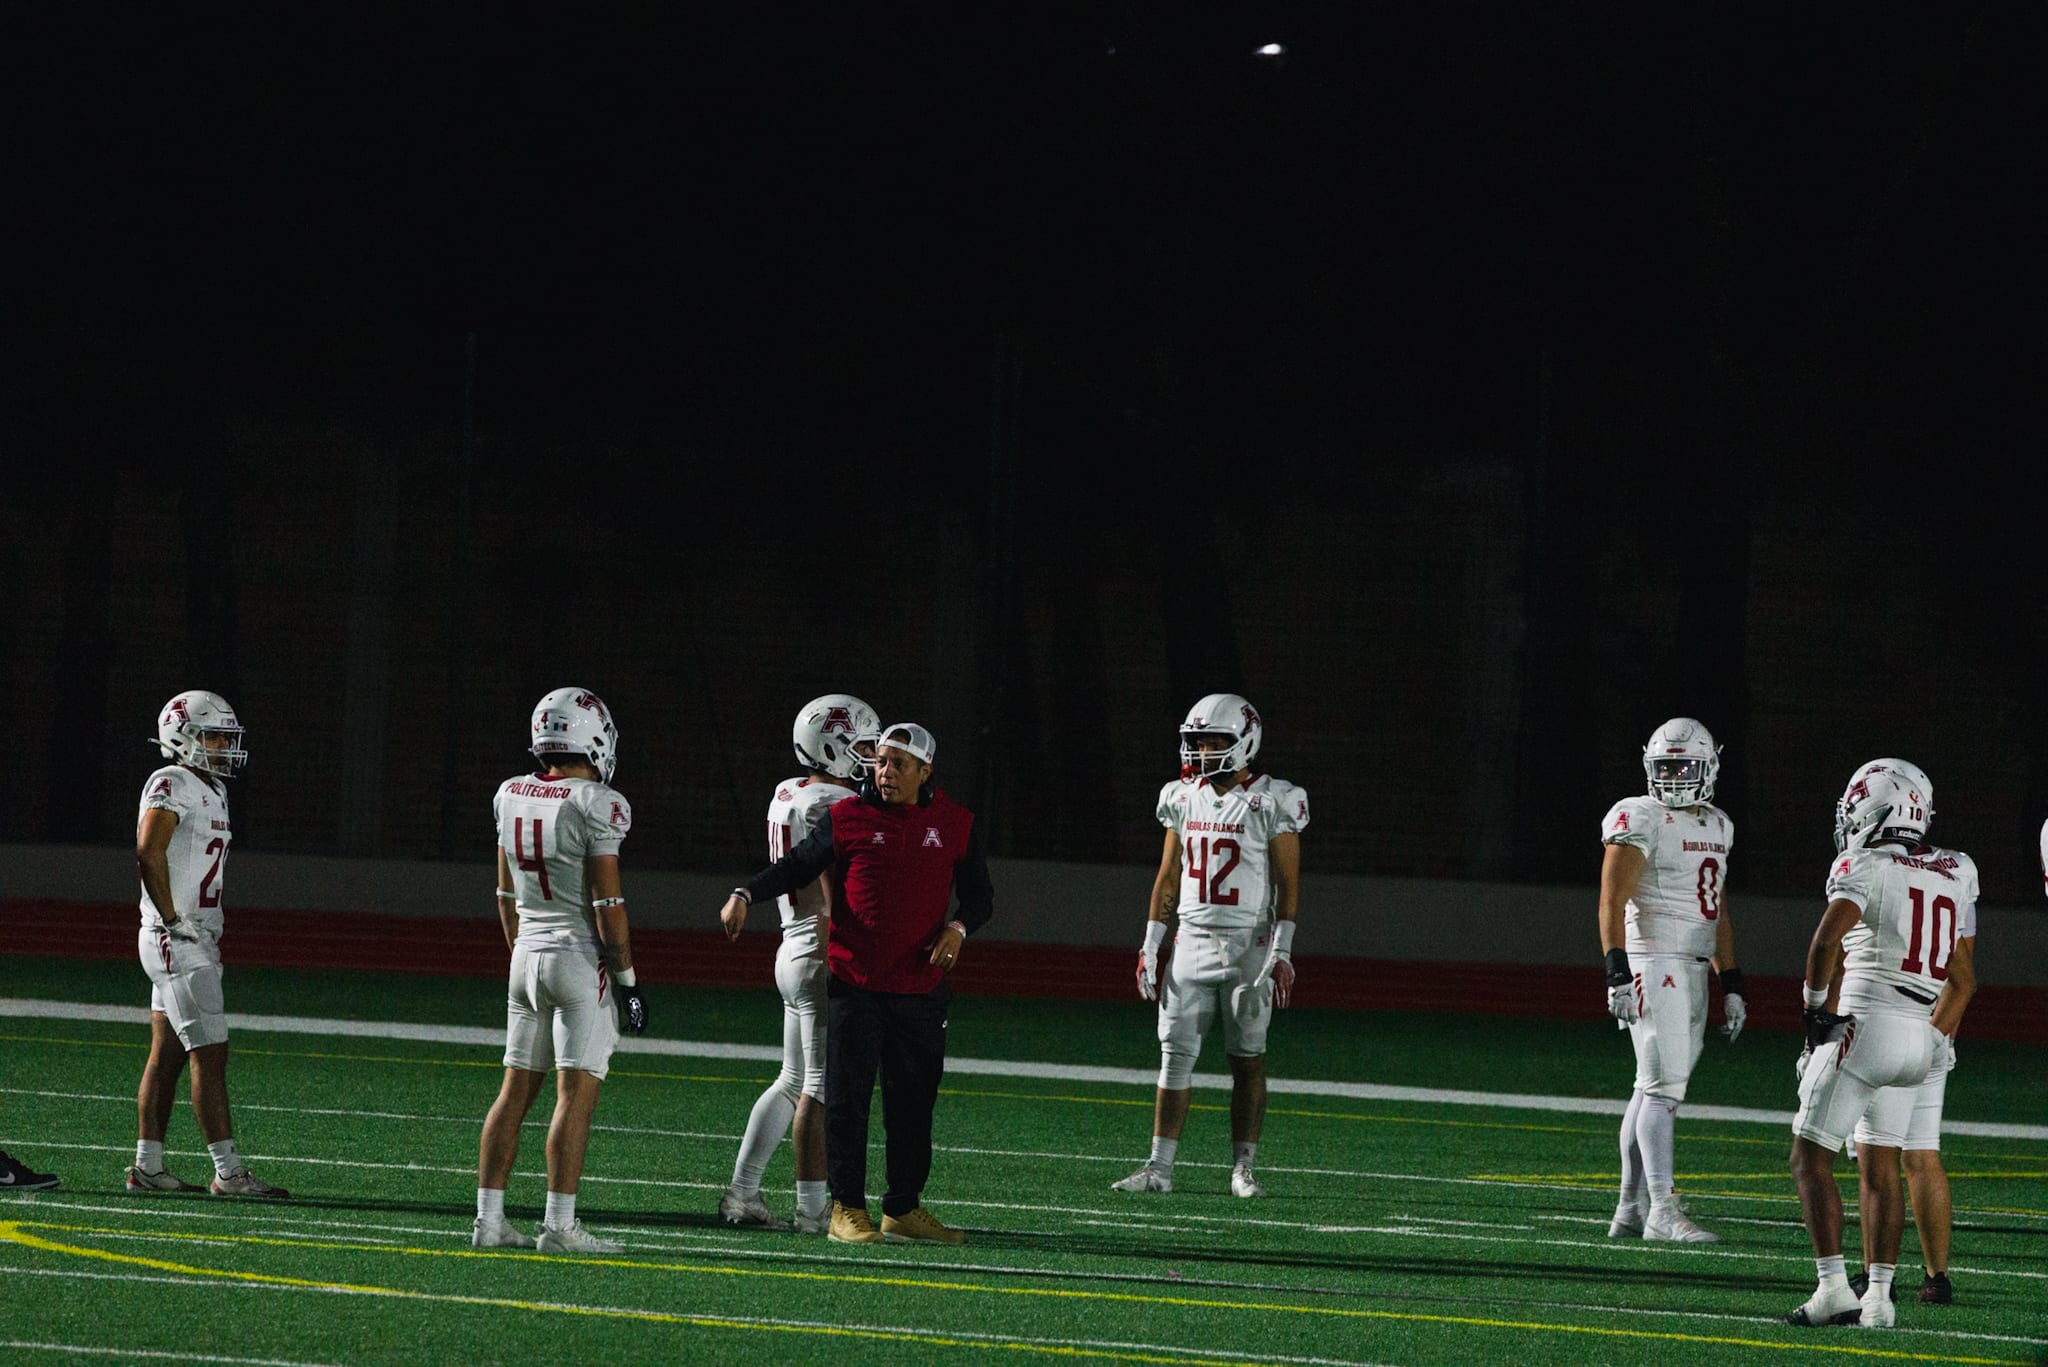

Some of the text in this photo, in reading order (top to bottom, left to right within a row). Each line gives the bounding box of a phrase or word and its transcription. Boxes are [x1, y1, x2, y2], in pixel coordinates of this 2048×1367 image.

[541, 711, 549, 724] 4
[505, 782, 571, 799] POLITECNICO
[1213, 822, 1246, 834] BLANCAS
[1909, 806, 1923, 821] 10
[515, 817, 552, 900] 4
[1187, 837, 1240, 905] 42
[1697, 857, 1719, 920] 0
[1901, 886, 1956, 981] 10
